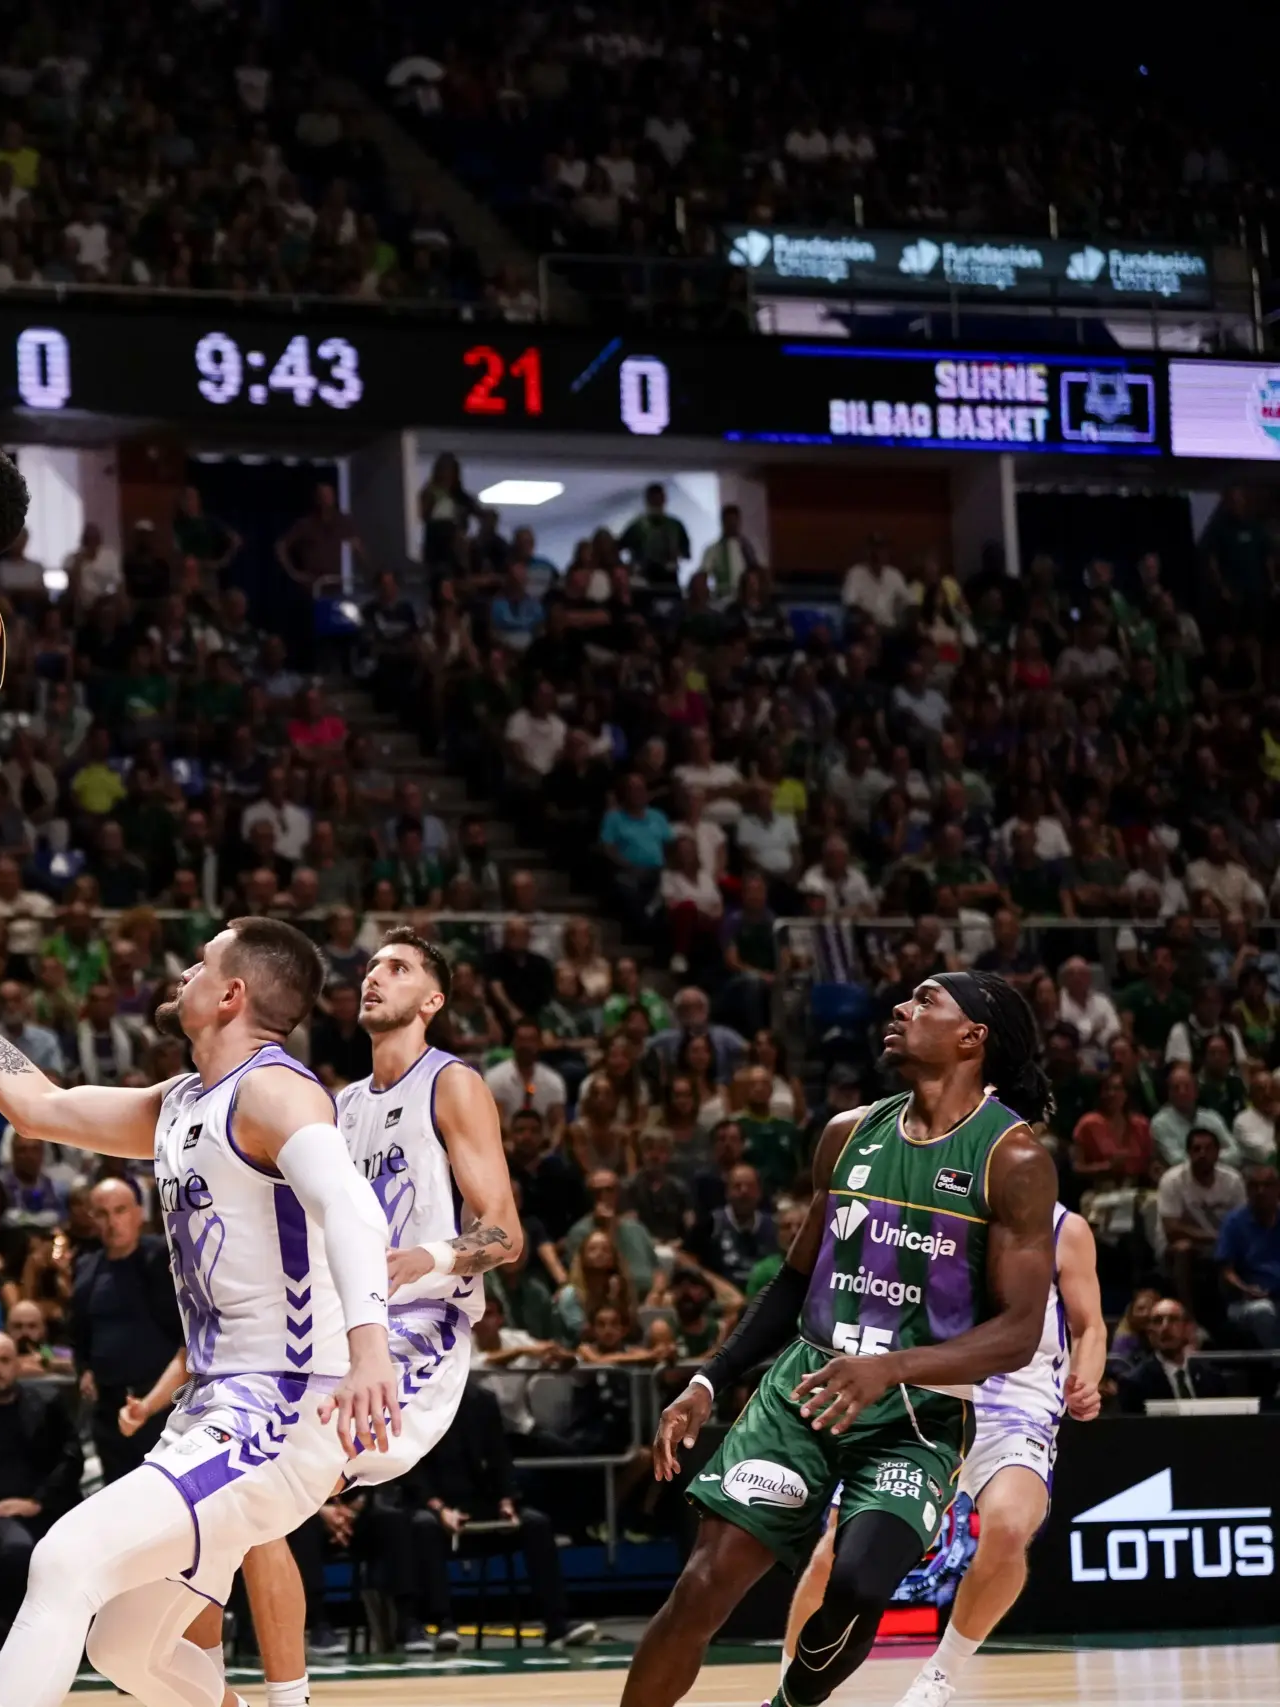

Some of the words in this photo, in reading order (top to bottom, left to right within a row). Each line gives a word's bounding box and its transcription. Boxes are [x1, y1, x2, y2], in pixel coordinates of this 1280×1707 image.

[17, 328, 71, 408] 0
[195, 331, 364, 409] 9:43
[463, 345, 543, 416] 21
[621, 355, 670, 435] 0
[935, 361, 1049, 402] SURNE
[829, 400, 932, 438] BILBAO
[936, 404, 1050, 442] BASKET
[937, 1181, 967, 1193] endesa
[870, 1219, 957, 1261] Unicaja
[1070, 1525, 1275, 1582] LOTUS
